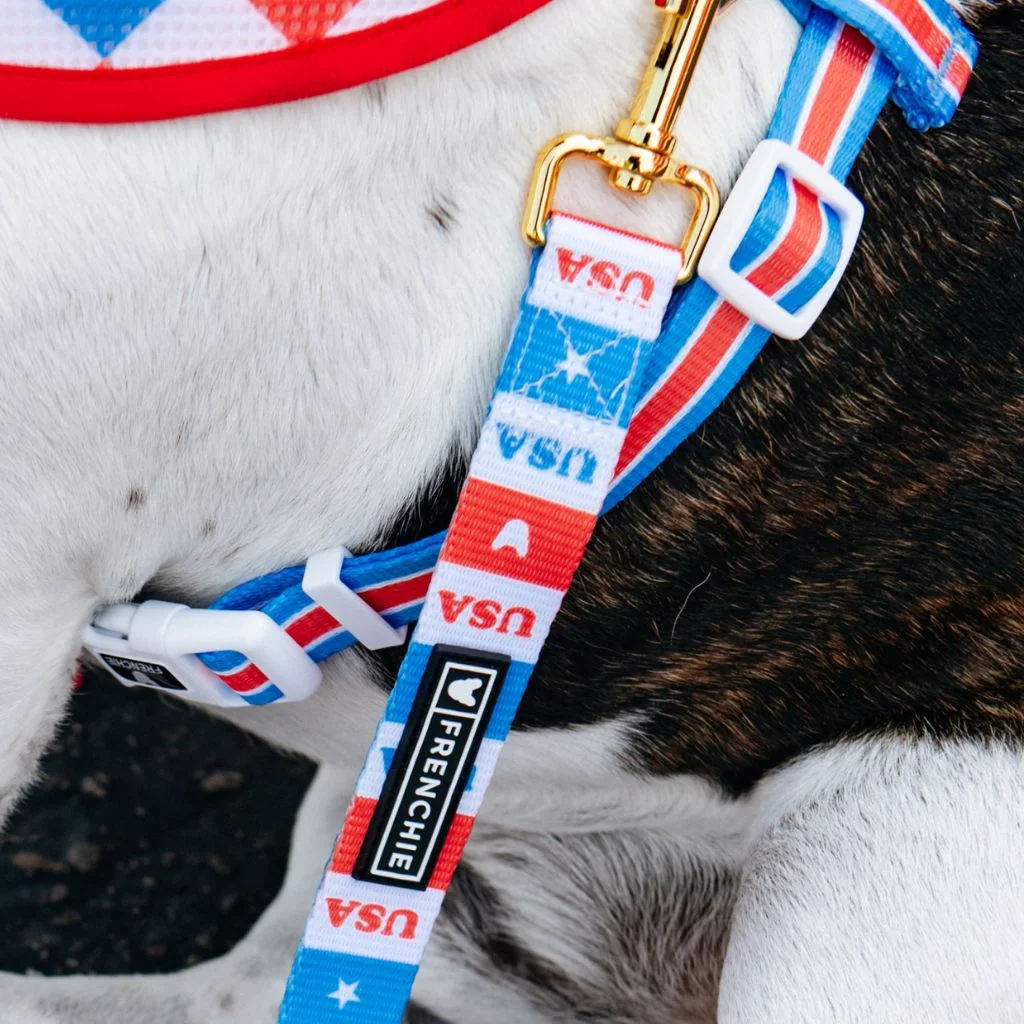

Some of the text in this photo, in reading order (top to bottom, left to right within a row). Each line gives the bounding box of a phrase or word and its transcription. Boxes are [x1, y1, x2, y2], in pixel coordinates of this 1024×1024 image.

[555, 247, 656, 309] USA
[495, 421, 599, 485] USA
[438, 590, 538, 638] USA
[387, 718, 462, 872] FRENCHIE
[325, 897, 420, 939] USA
